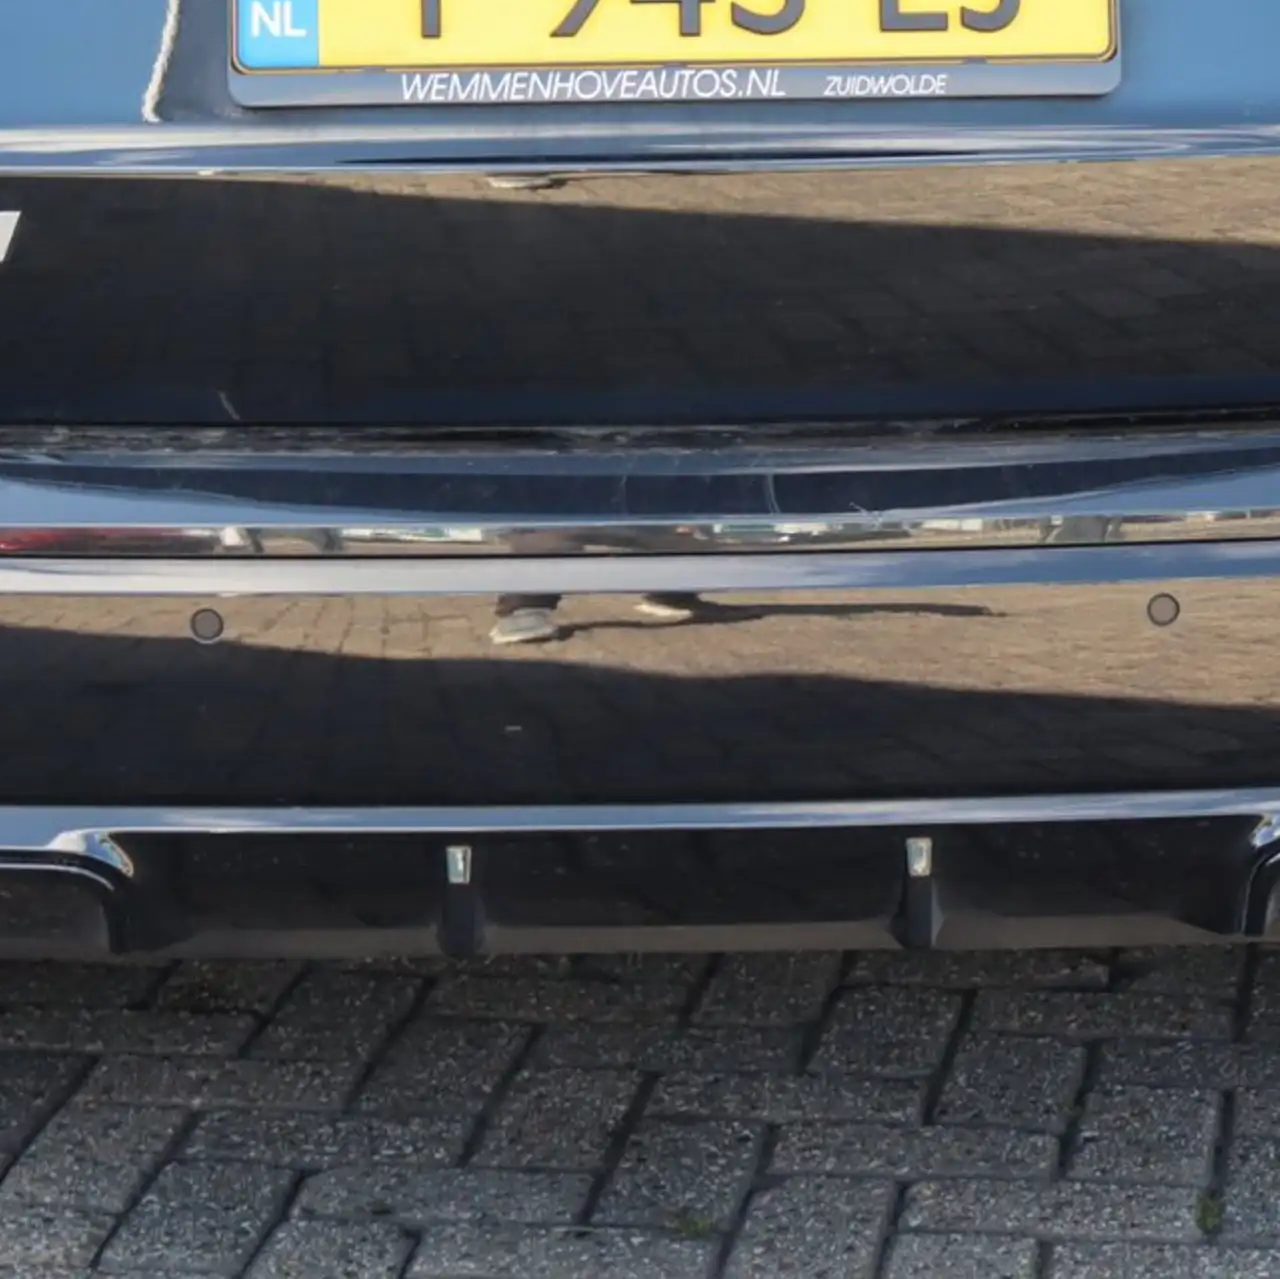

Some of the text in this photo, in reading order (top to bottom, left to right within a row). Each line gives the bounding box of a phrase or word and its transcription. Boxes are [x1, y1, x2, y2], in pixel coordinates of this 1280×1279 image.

[251, 0, 307, 37] NL
[401, 69, 949, 101] WEMMENHOVEAUTOS.NL ZUIDWOLDE
